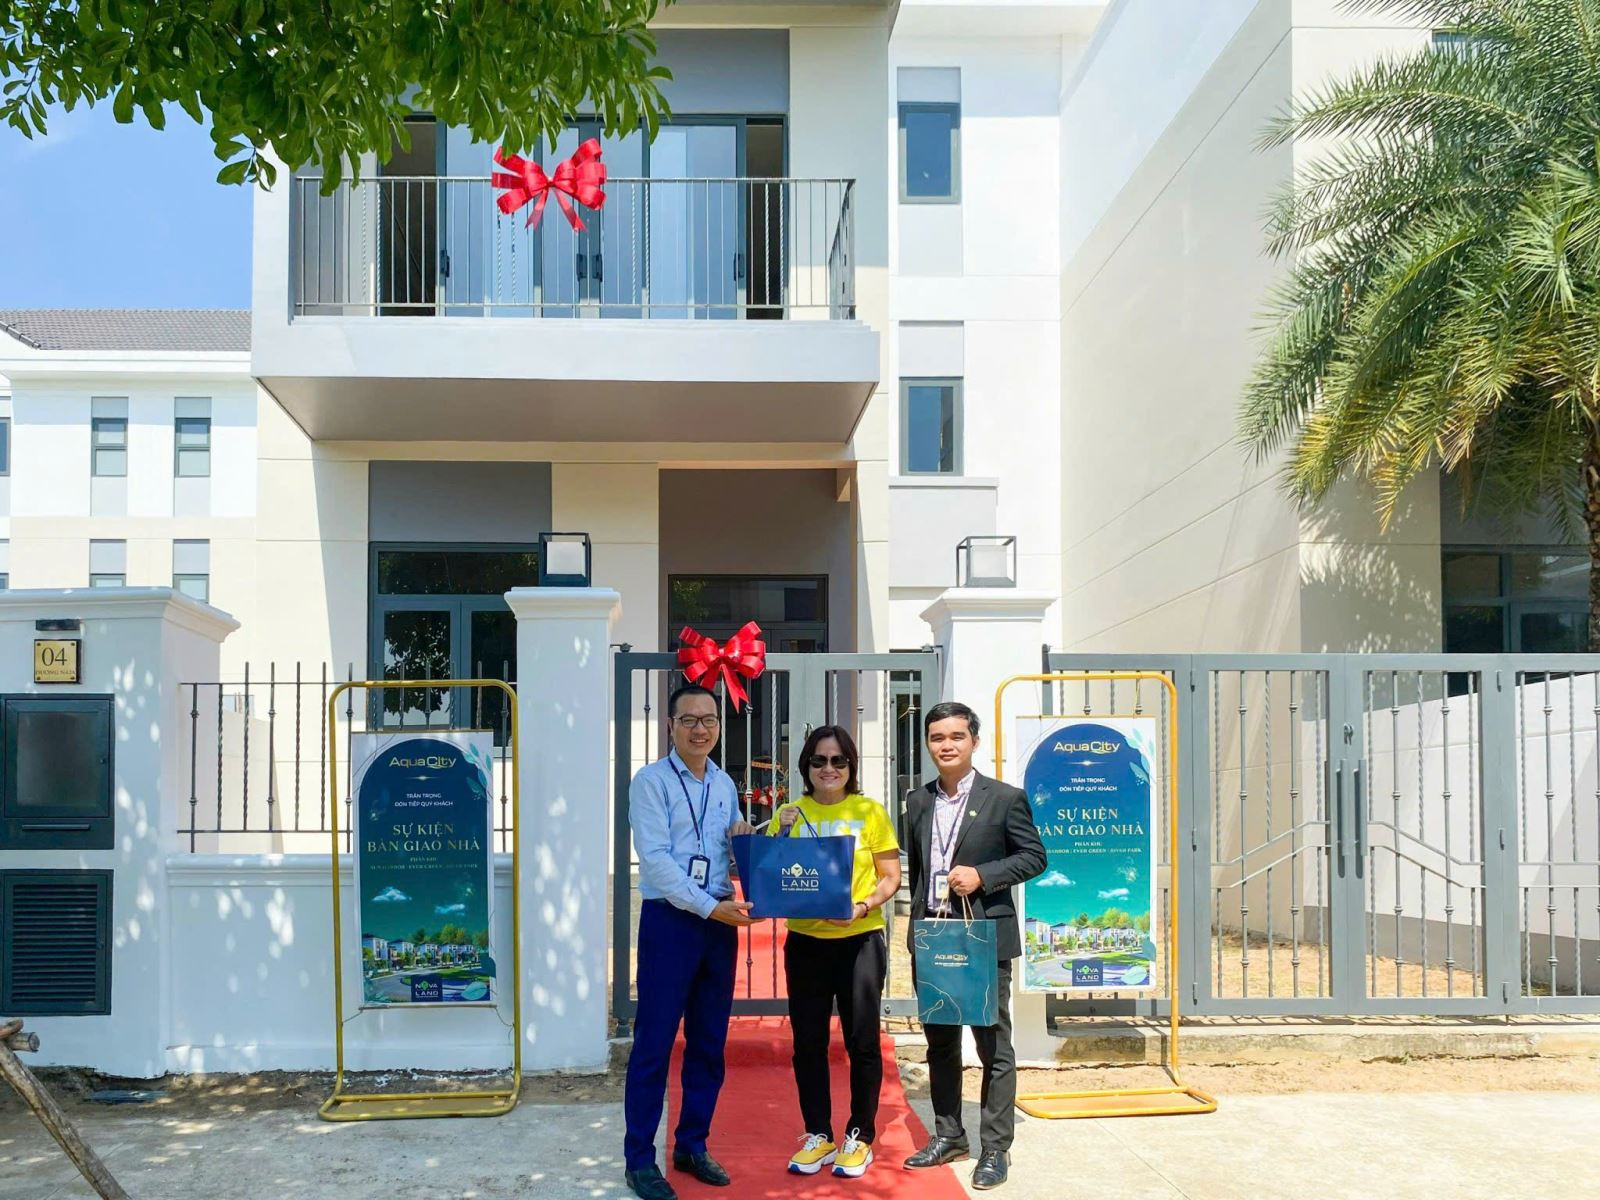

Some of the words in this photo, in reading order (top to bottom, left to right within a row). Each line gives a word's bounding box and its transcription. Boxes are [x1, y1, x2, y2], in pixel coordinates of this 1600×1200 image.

[42, 647, 68, 666] 04
[1068, 825, 1106, 836] GIAO
[403, 840, 442, 851] GIAO
[781, 863, 819, 877] NOVA
[781, 879, 819, 888] LAND
